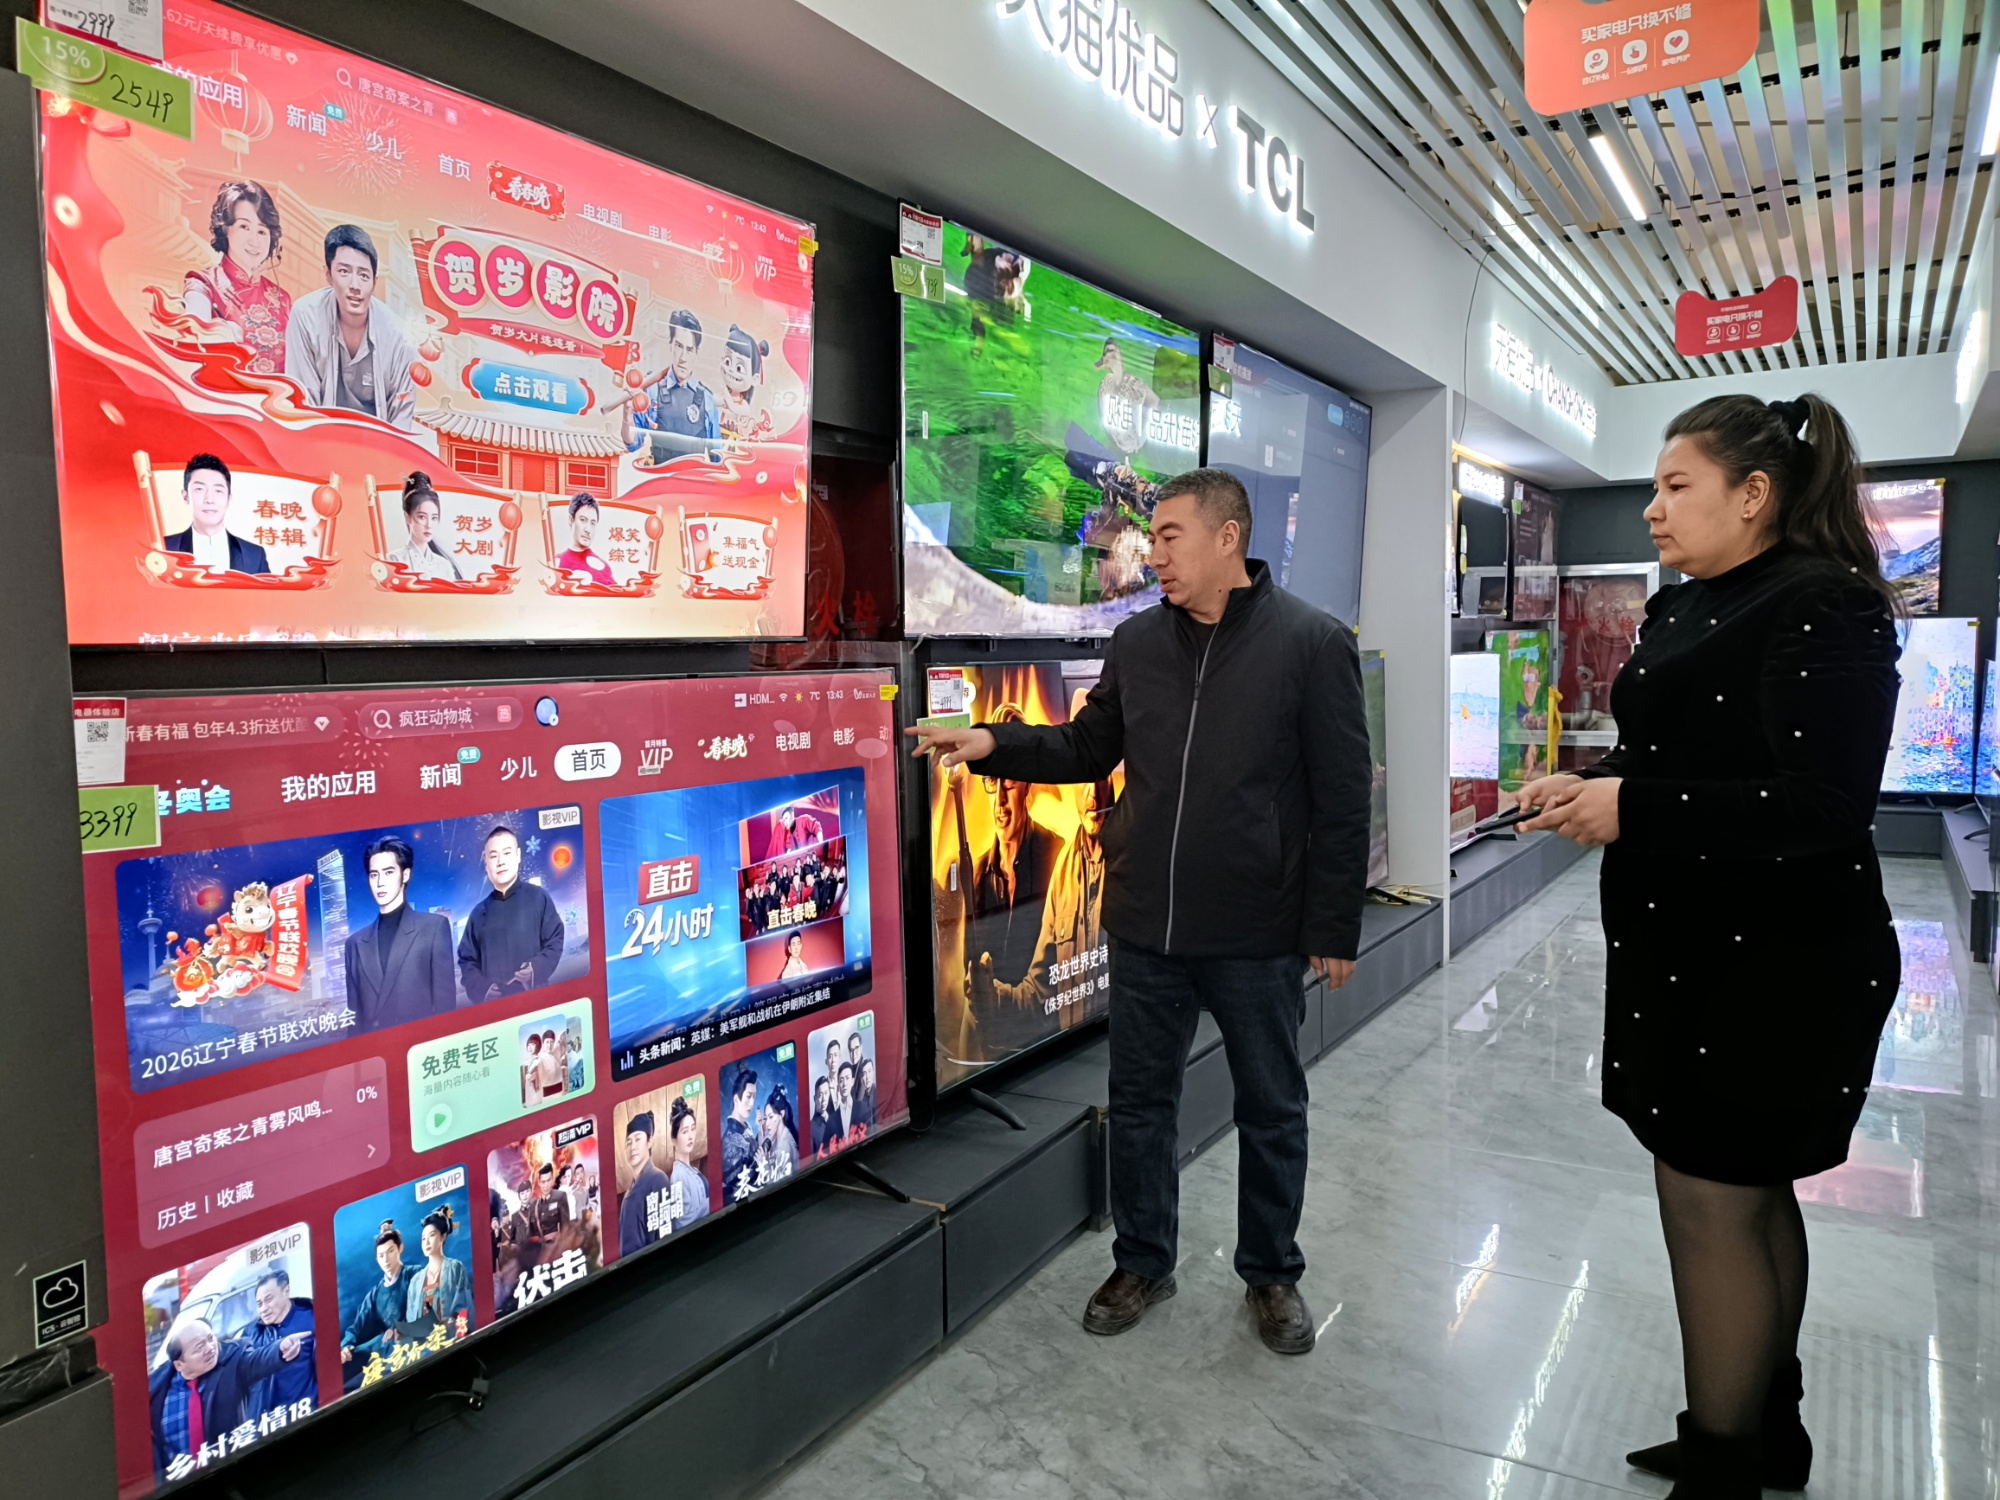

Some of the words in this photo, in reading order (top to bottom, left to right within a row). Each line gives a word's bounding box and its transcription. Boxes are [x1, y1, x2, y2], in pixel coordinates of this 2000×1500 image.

[78, 11, 115, 38] 2999
[1581, 3, 1692, 45] 买家电只换不修
[42, 36, 91, 69] 15%
[110, 73, 173, 123] 2549
[358, 76, 434, 117] 唐宫奇案之青
[287, 104, 327, 137] 新闻
[366, 131, 402, 160] 少儿
[438, 153, 471, 182] 首页
[1229, 105, 1315, 235] TCL
[503, 175, 551, 210] 看春晚
[582, 202, 623, 229] 电视剧
[750, 220, 767, 233] 13:43
[648, 224, 673, 243] 电影
[754, 260, 777, 282] VIP
[444, 253, 619, 333] 贺岁影院
[493, 372, 568, 405] 点击观看
[253, 499, 307, 521] 春晚
[453, 514, 493, 533] 贺岁
[253, 526, 307, 547] 特辑
[455, 539, 494, 557] 大剧
[608, 526, 641, 543] 爆笑
[722, 536, 760, 551] 集福气
[608, 547, 641, 564] 综艺
[722, 555, 760, 570] 送现金
[826, 690, 843, 700] 13:43
[74, 707, 120, 717] 电器体验店
[399, 707, 472, 728] 疯狂动物城
[775, 730, 811, 751] 电视剧
[833, 727, 855, 746] 电影
[879, 724, 892, 741] 动
[571, 748, 606, 772] 首页
[640, 747, 673, 769] VIP
[704, 733, 748, 760] 看春晚
[419, 763, 462, 790] 新闻
[500, 756, 537, 781] 少儿
[281, 770, 376, 803] 我的应用
[80, 802, 138, 839] 3399
[542, 811, 578, 826] 影视VIP
[646, 861, 693, 899] 直击
[766, 901, 817, 930] 直击春晚
[275, 881, 301, 978] 辽宁春节联欢晚会
[621, 903, 714, 958] 24小时
[141, 1007, 356, 1079] 2026辽宁春节联欢晚会
[421, 1036, 499, 1079] 免费专区
[356, 1086, 378, 1103] 0%
[423, 1065, 490, 1097] 海量内容随心看
[557, 1122, 592, 1145] 超清VIP
[419, 1171, 462, 1197] 影视VIP
[157, 1201, 198, 1230] 历史
[217, 1181, 254, 1209] 收藏
[249, 1233, 302, 1265] 影视VIP
[514, 1248, 587, 1310] 伏击
[165, 1397, 312, 1482] 乡村爱情18
